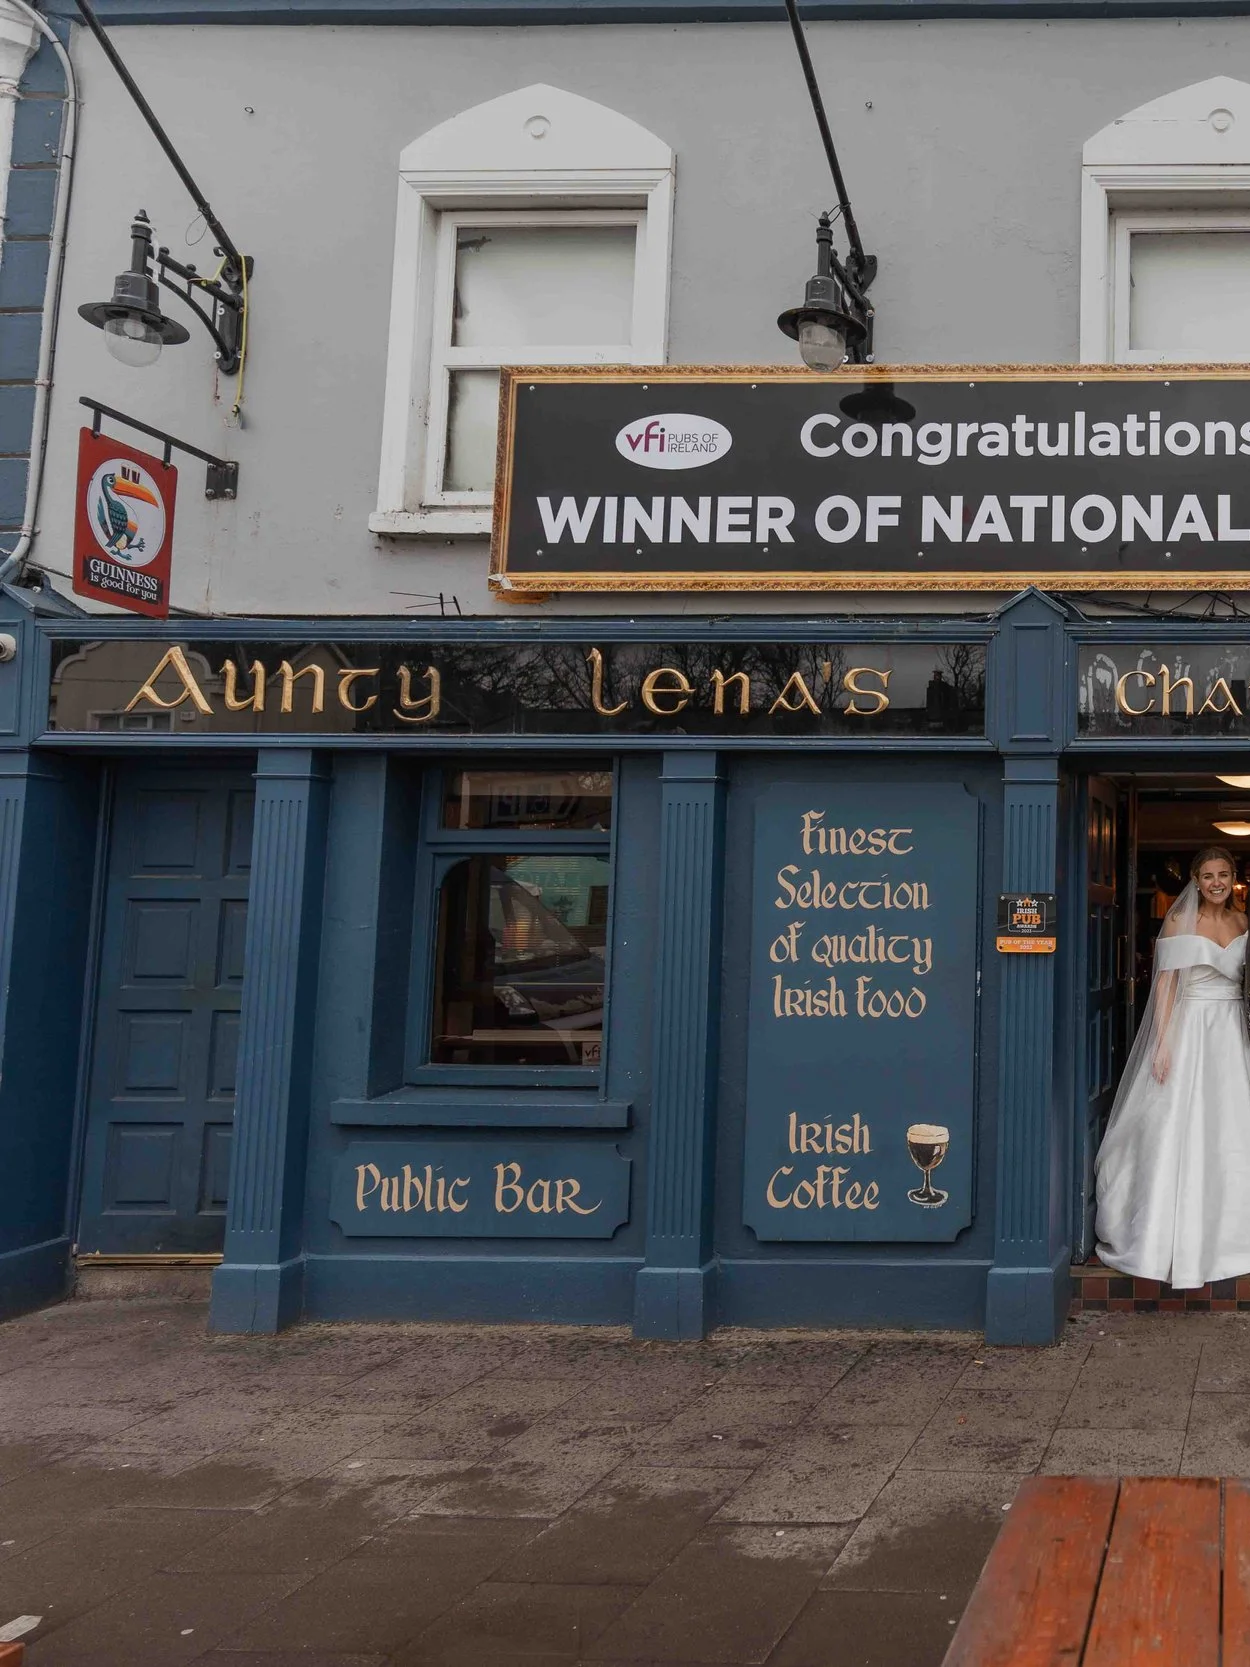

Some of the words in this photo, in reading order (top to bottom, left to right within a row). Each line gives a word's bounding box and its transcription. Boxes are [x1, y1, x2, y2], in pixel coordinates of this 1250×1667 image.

[625, 421, 665, 452] vfi
[668, 433, 698, 443] PUBS
[701, 433, 718, 443] OF
[668, 443, 717, 453] IRELAND
[537, 495, 796, 544] WINNER
[814, 495, 902, 544] OF
[89, 558, 158, 592] GUINNESS
[90, 572, 99, 582] is
[101, 577, 125, 588] good
[126, 583, 139, 595] for
[141, 589, 157, 600] you
[126, 646, 442, 722] Aunty
[774, 864, 932, 910] Selection
[1012, 914, 1041, 924] PUB
[769, 922, 806, 963] of
[811, 925, 933, 975] quality
[773, 975, 848, 1018] Irish
[788, 1111, 872, 1154] Irish
[355, 1162, 471, 1212] Public
[493, 1161, 603, 1215] Bar
[766, 1165, 880, 1210] Coffee
